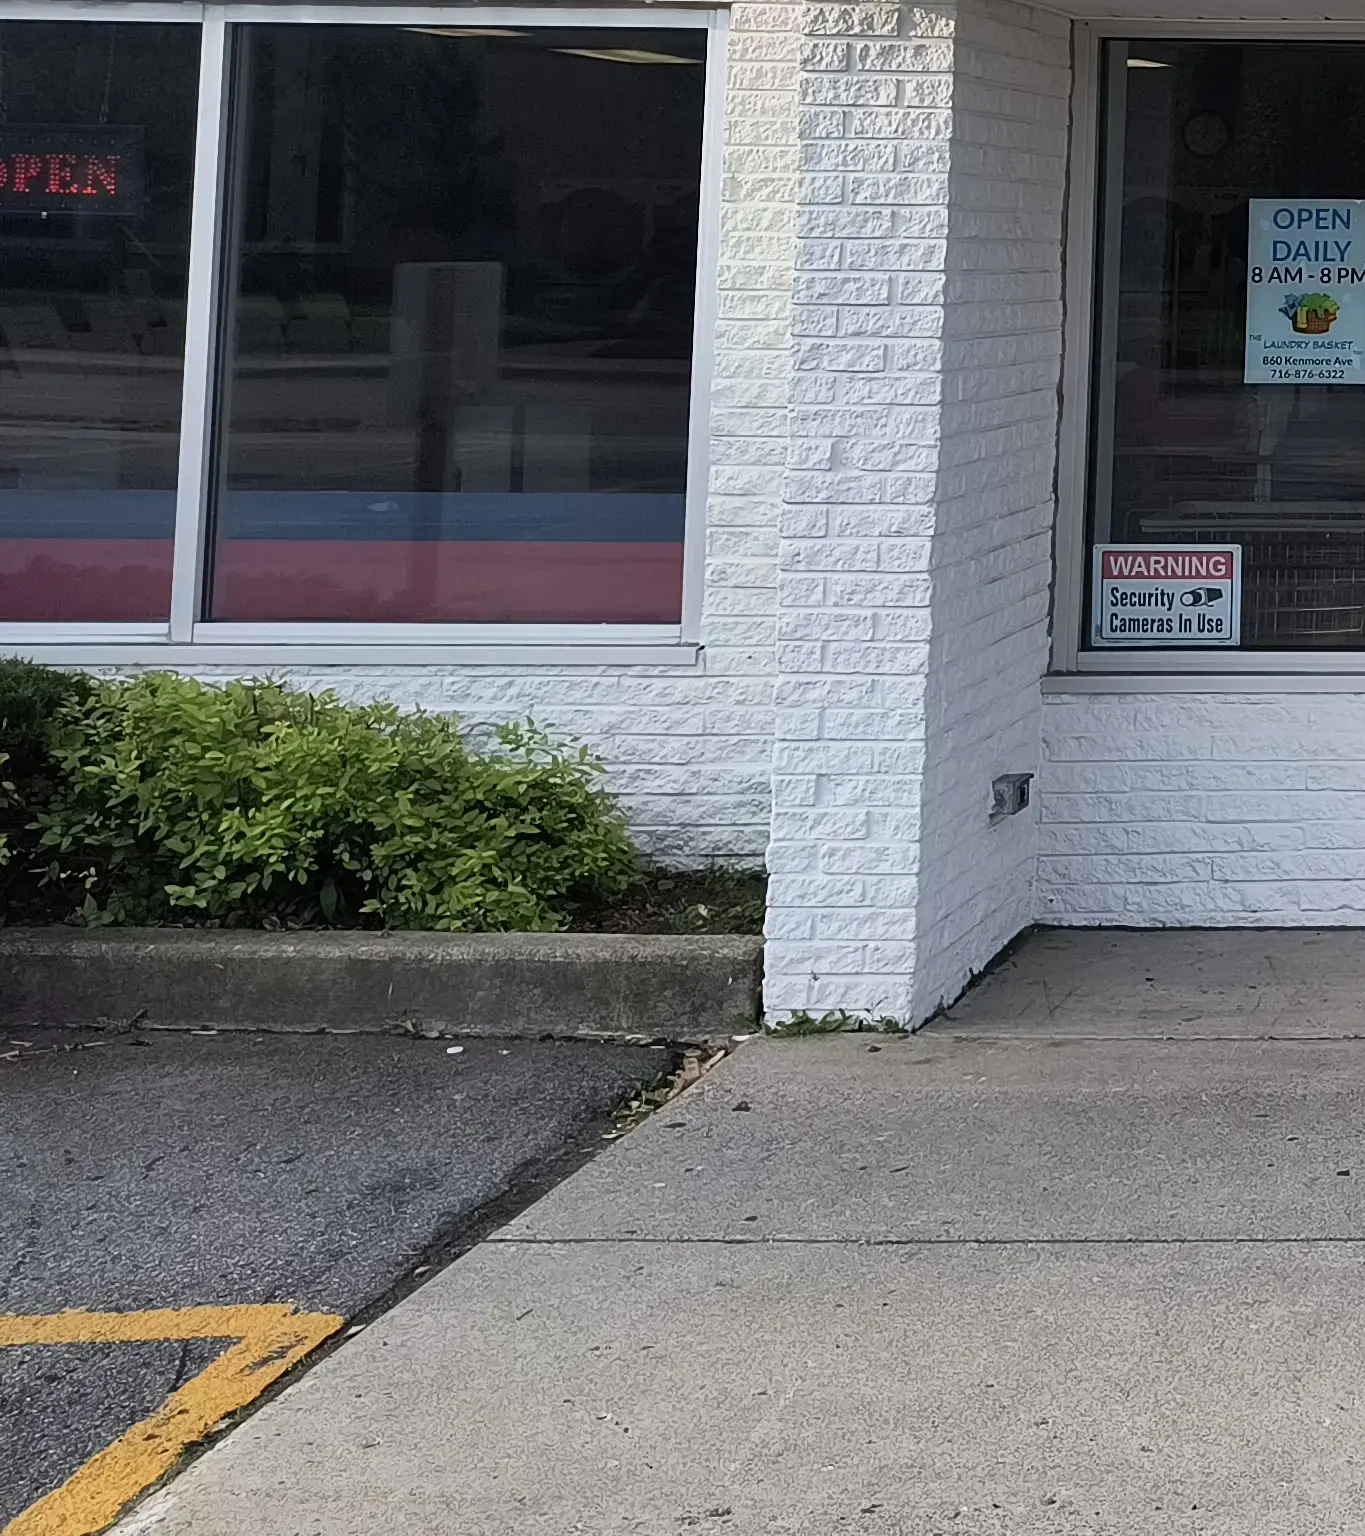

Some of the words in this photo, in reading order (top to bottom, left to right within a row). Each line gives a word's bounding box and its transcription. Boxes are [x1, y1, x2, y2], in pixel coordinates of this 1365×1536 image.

[0, 152, 121, 194] PEN
[1272, 208, 1351, 230] OPEN
[1272, 240, 1352, 262] DAILY
[1251, 266, 1263, 284] 8
[1267, 267, 1302, 283] AM
[1319, 267, 1331, 284] 8
[1263, 340, 1311, 349] LAUNDRY
[1312, 340, 1354, 350] BASKET
[1262, 356, 1282, 365] 860
[1284, 356, 1331, 366] Kenmore
[1333, 356, 1353, 366] Ave
[1270, 369, 1345, 379] 716-876-6322
[1109, 556, 1226, 576] WARNING
[1110, 586, 1175, 612] Security
[1109, 612, 1173, 633] Cameras
[1178, 613, 1192, 633] In
[1197, 613, 1223, 633] Use
